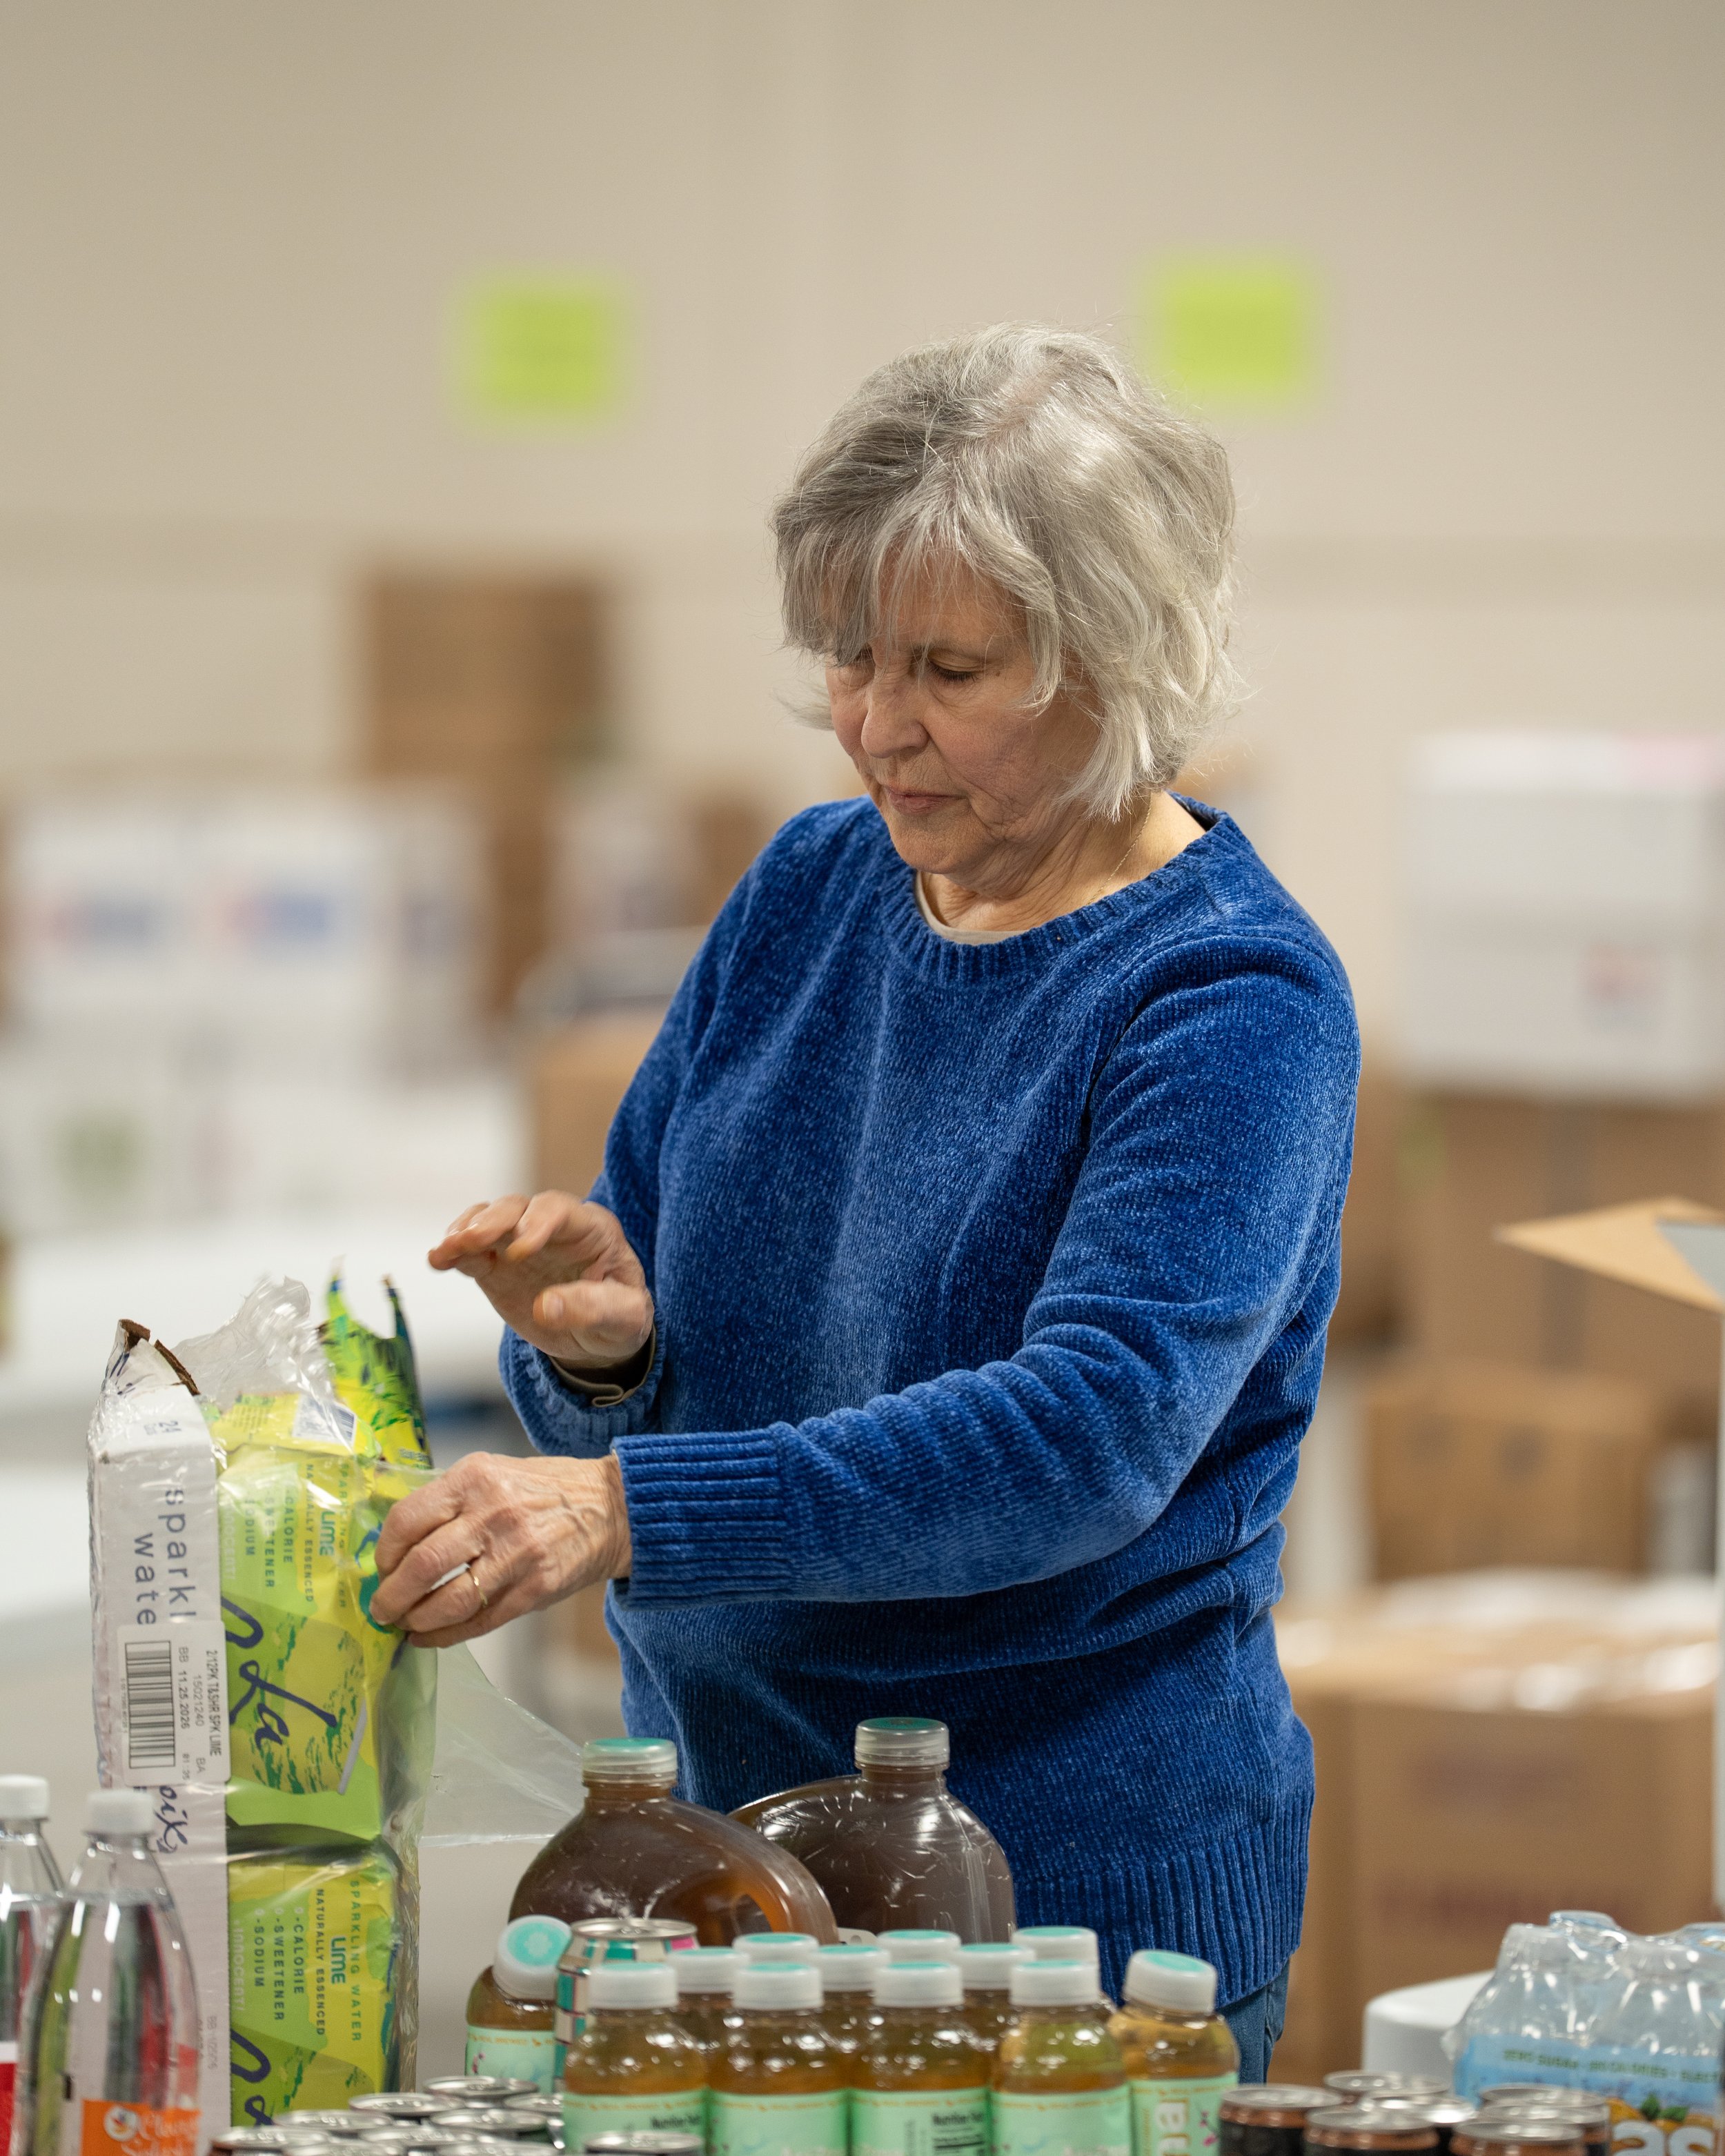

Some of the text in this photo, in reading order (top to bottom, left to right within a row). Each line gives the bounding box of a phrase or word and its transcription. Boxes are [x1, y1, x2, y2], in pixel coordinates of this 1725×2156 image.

[303, 1464, 314, 1603] NAURALLY ESSENCED
[178, 1647, 188, 1663] BB
[177, 1671, 189, 1729] 11.25.2026
[192, 1675, 206, 1774] 15021240 BA
[208, 1715, 220, 1733] SPK
[208, 1735, 221, 1757] LIME
[315, 1888, 325, 2035] NATURALLY ESSENCED
[330, 1937, 346, 1984] LIME
[349, 1881, 362, 2042] SPARKLING WATER
